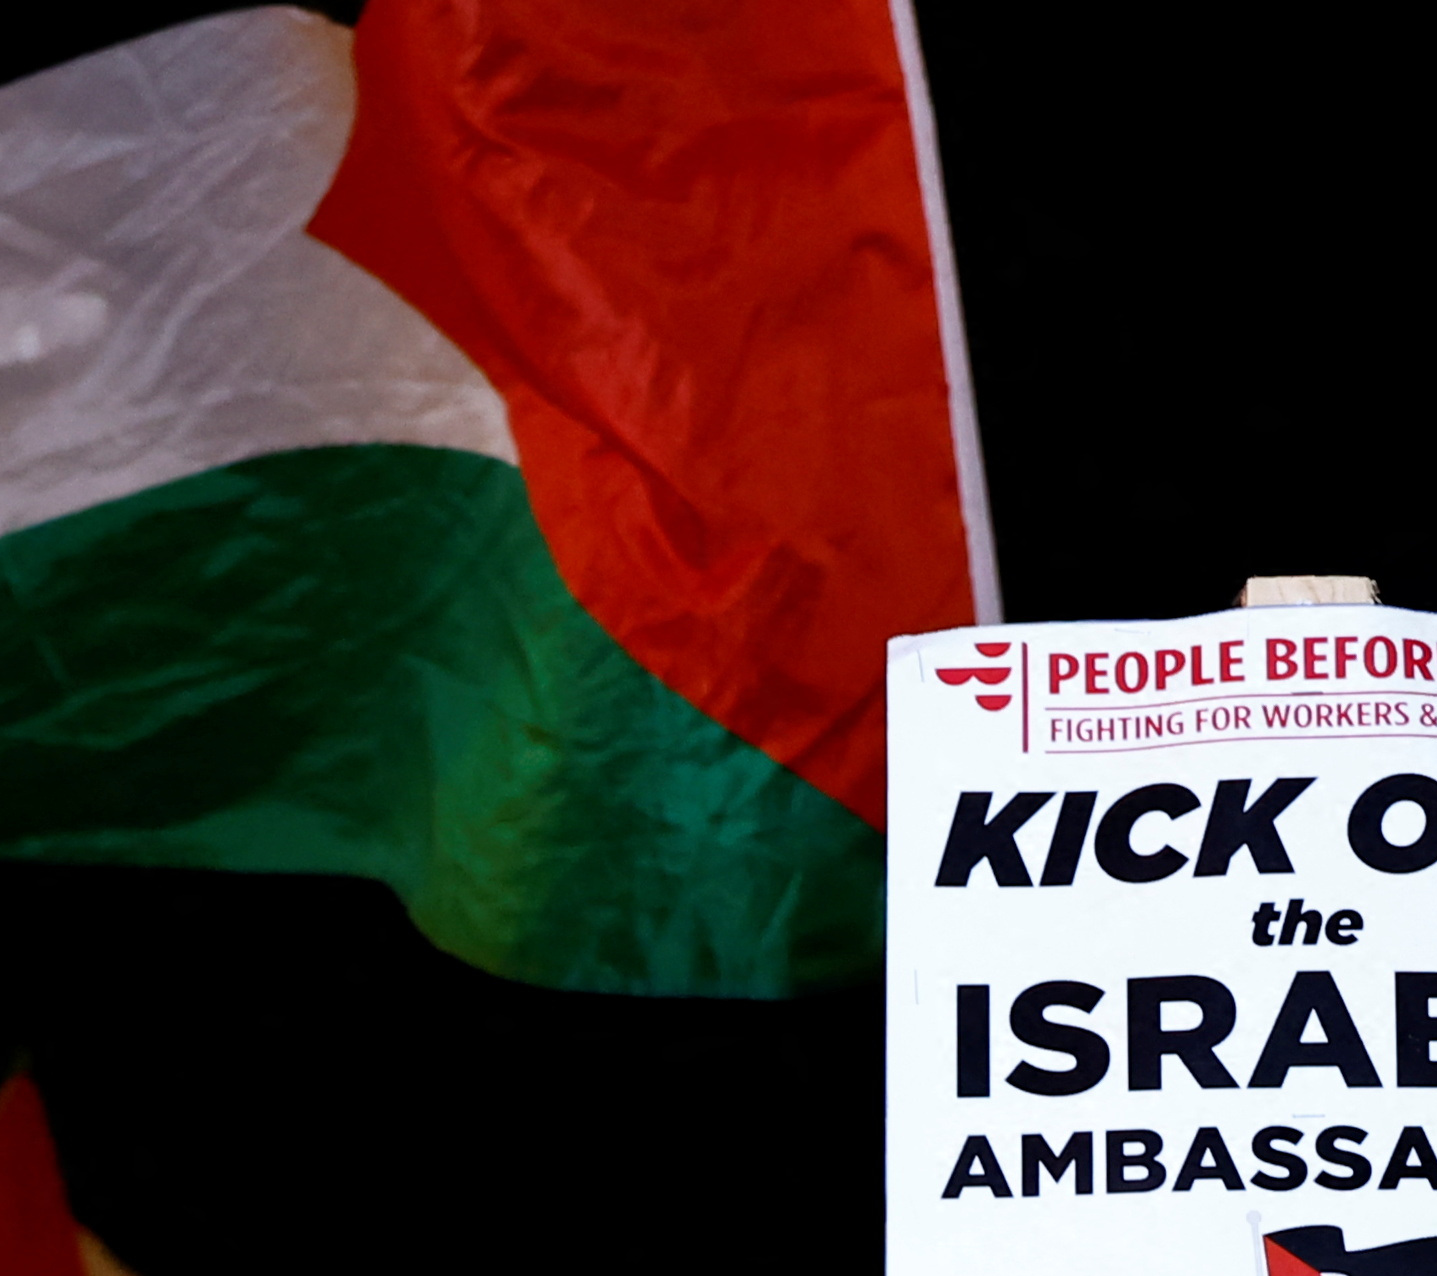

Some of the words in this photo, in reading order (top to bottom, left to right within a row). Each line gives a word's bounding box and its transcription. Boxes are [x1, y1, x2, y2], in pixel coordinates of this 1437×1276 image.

[1047, 640, 1245, 695] PEOPLE
[1049, 708, 1186, 745] FIGHTING
[1194, 705, 1256, 734] FOR
[1261, 701, 1411, 731] WORKERS
[933, 775, 1319, 888] KICK
[1250, 898, 1365, 947] the
